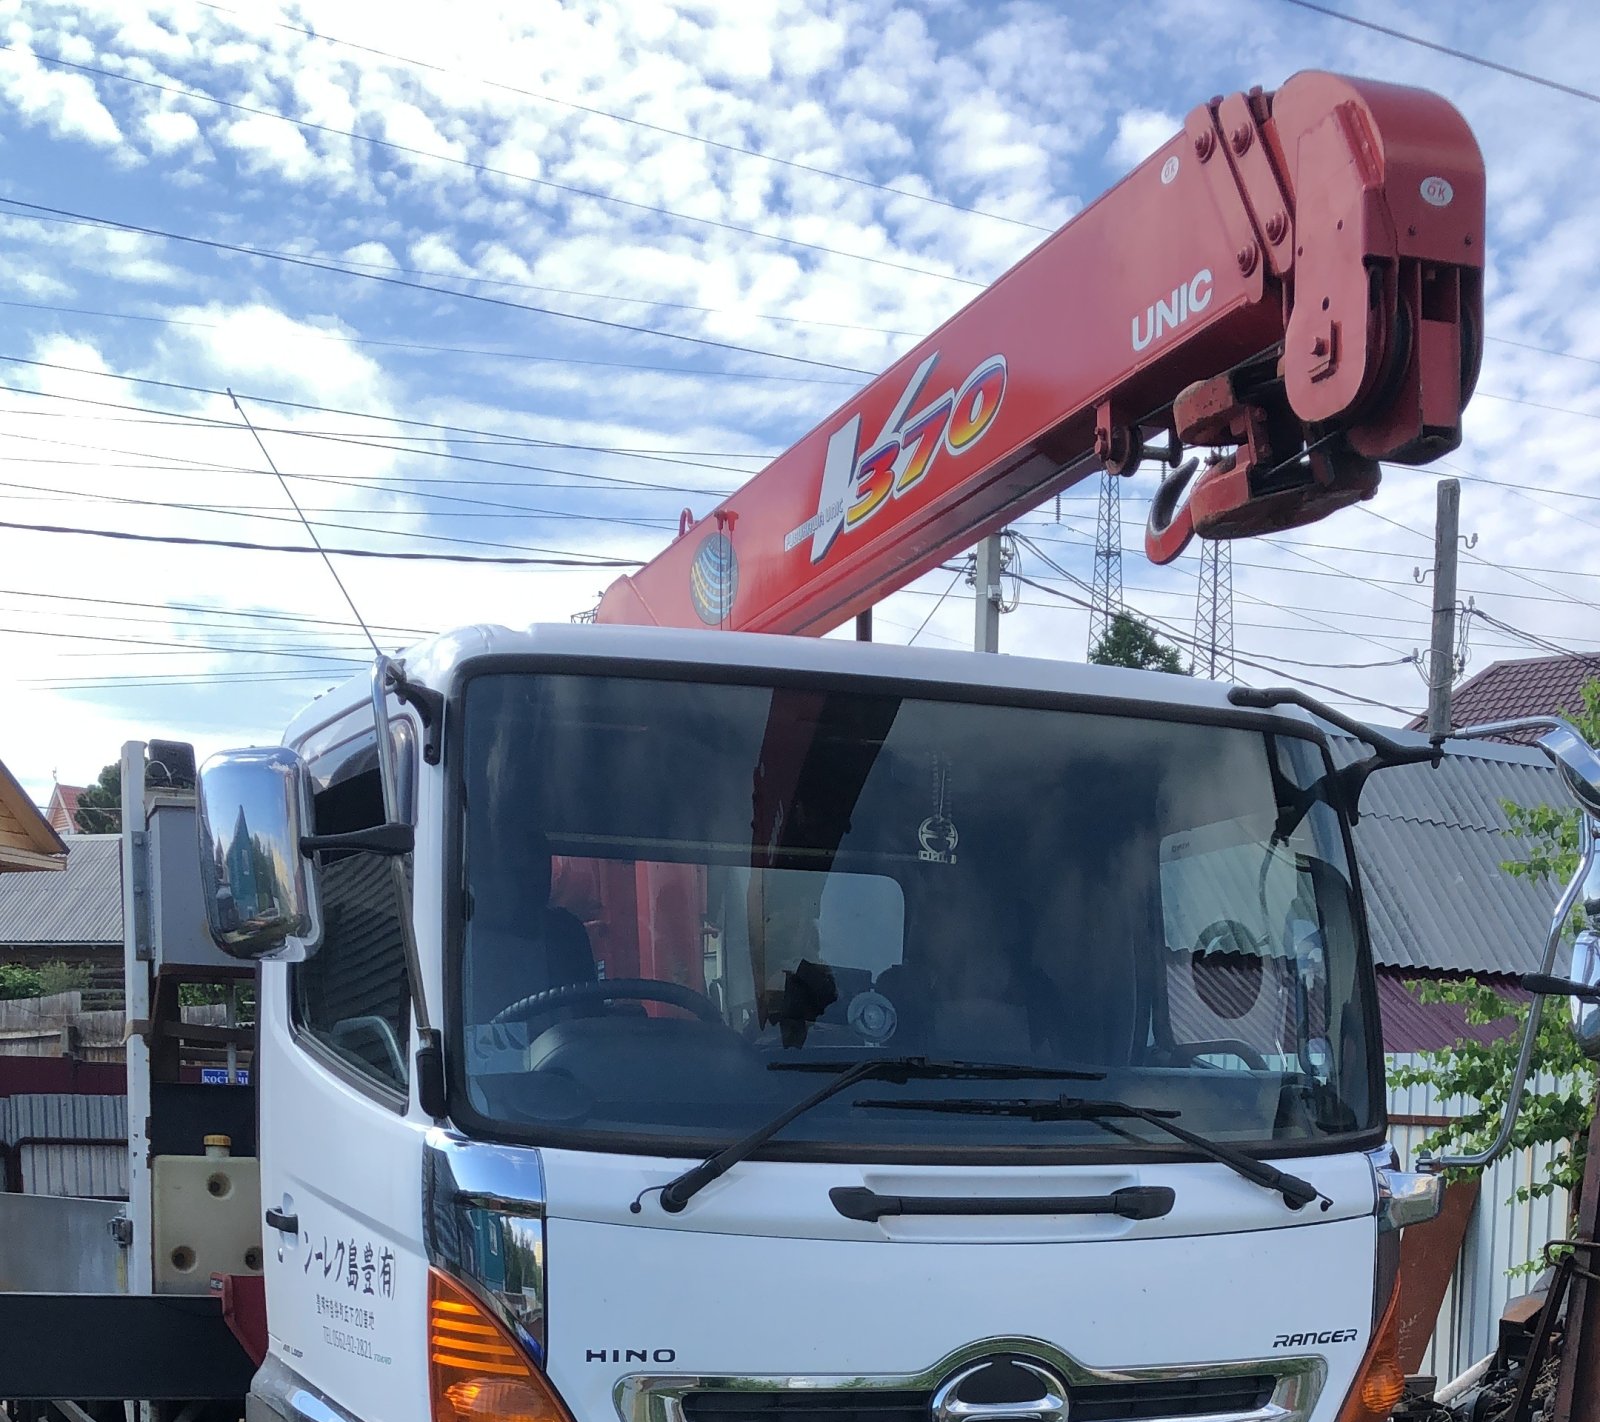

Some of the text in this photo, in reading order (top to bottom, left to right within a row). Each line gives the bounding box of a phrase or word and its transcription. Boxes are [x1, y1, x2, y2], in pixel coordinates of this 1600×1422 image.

[1131, 268, 1214, 352] UNIC
[844, 353, 1008, 534] 370
[585, 1349, 676, 1363] HINO
[1272, 1328, 1358, 1348] RANGER
